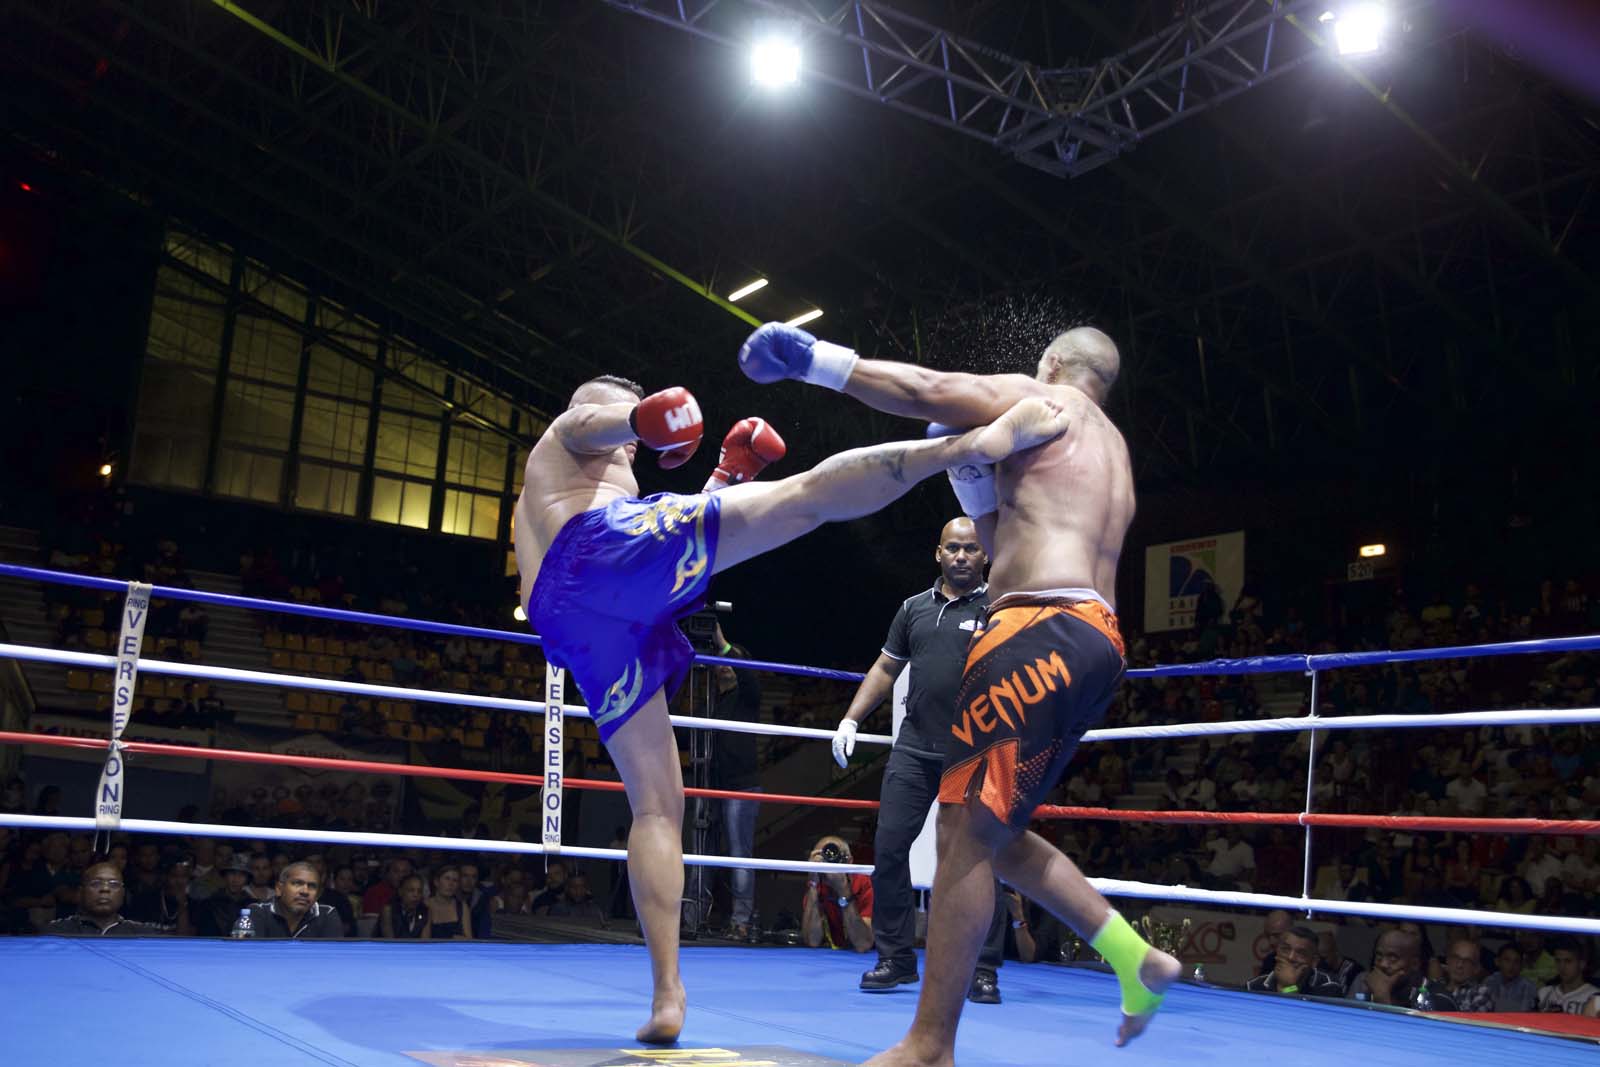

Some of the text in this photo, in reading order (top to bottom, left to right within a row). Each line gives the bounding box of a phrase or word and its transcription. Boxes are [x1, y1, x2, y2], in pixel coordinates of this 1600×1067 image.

[127, 598, 147, 610] RING
[102, 610, 142, 803] VERSEON
[951, 650, 1072, 748] VENUM
[546, 665, 562, 833] VERSERON
[99, 804, 120, 815] RING
[544, 834, 560, 844] RING
